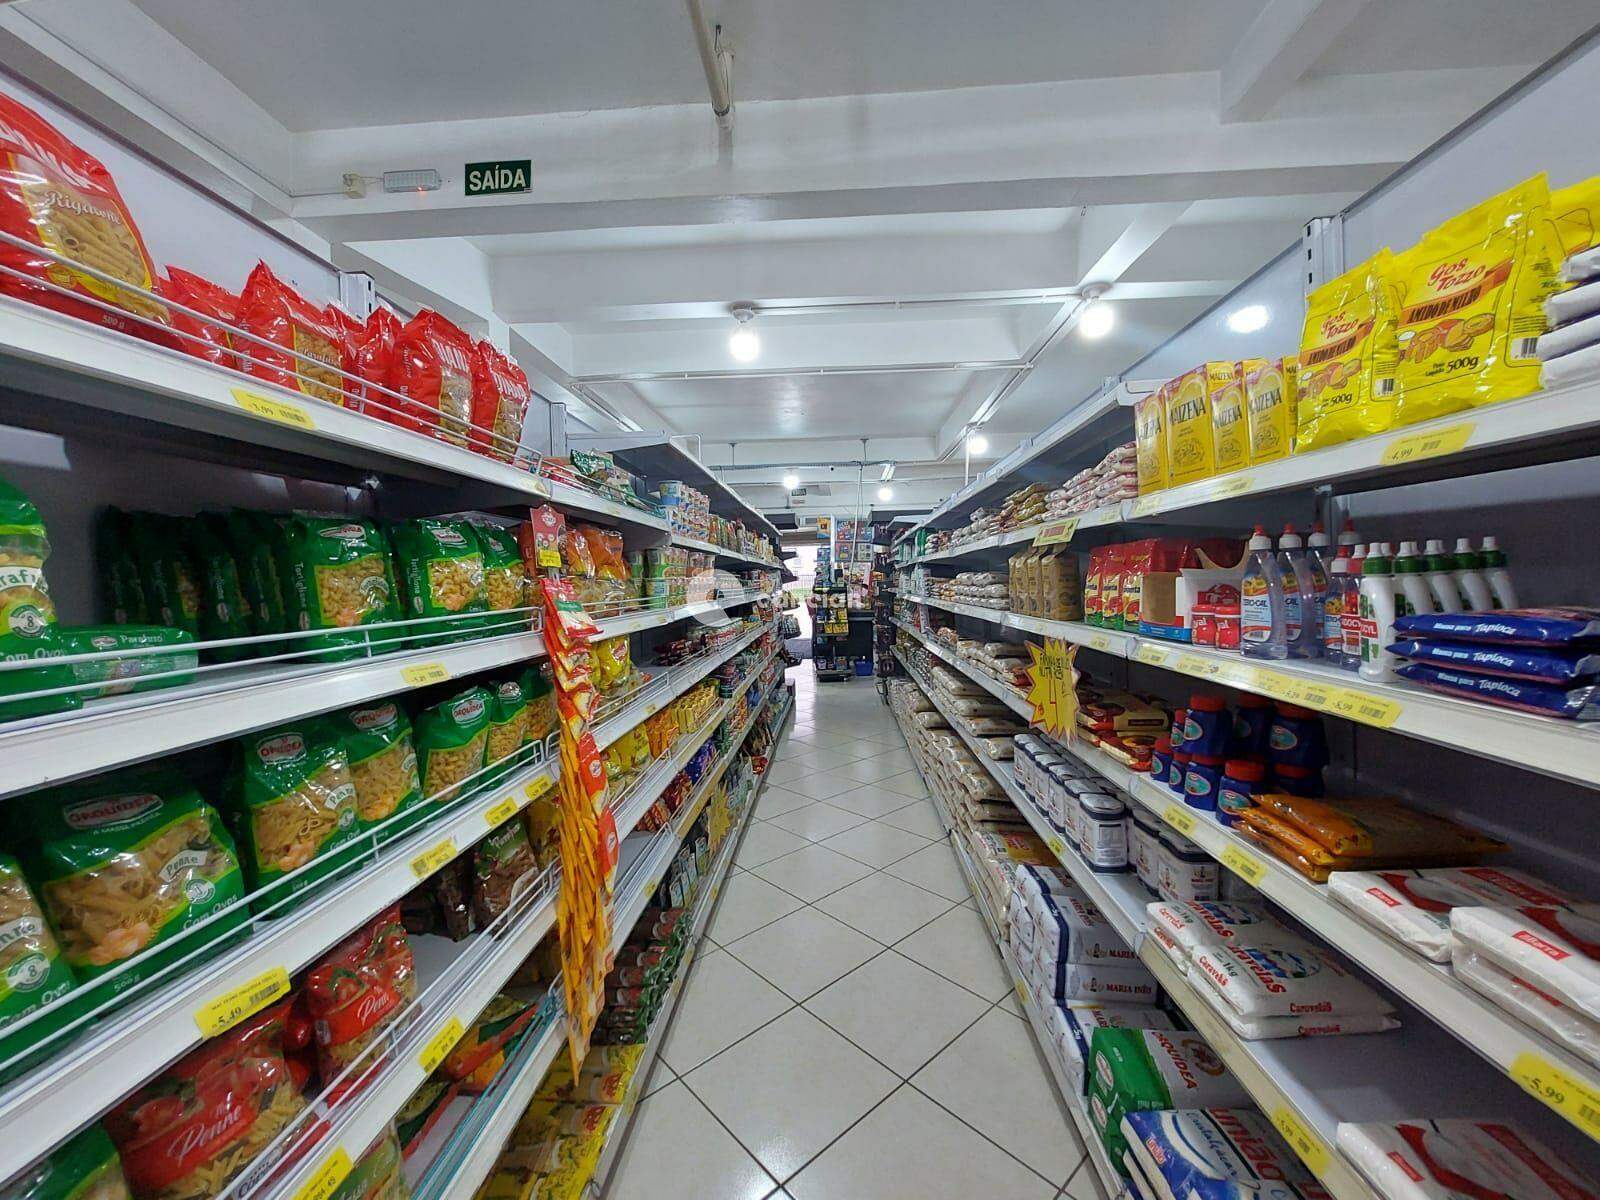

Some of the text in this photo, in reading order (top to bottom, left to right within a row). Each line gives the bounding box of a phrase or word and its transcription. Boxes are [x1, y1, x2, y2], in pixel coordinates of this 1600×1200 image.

[469, 165, 526, 192] SAÍDA
[1446, 356, 1479, 374] 500g
[1209, 371, 1233, 381] MAIZEN
[1170, 396, 1207, 425] MAIZENA
[26, 615, 34, 628] 8
[1474, 623, 1517, 635] Tapioca
[1473, 652, 1515, 668] Tapioca
[1479, 679, 1521, 697] Tapioca
[166, 855, 199, 878] Penne
[28, 963, 37, 978] 8
[1106, 984, 1133, 993] MARIA
[167, 1105, 241, 1168] Penne
